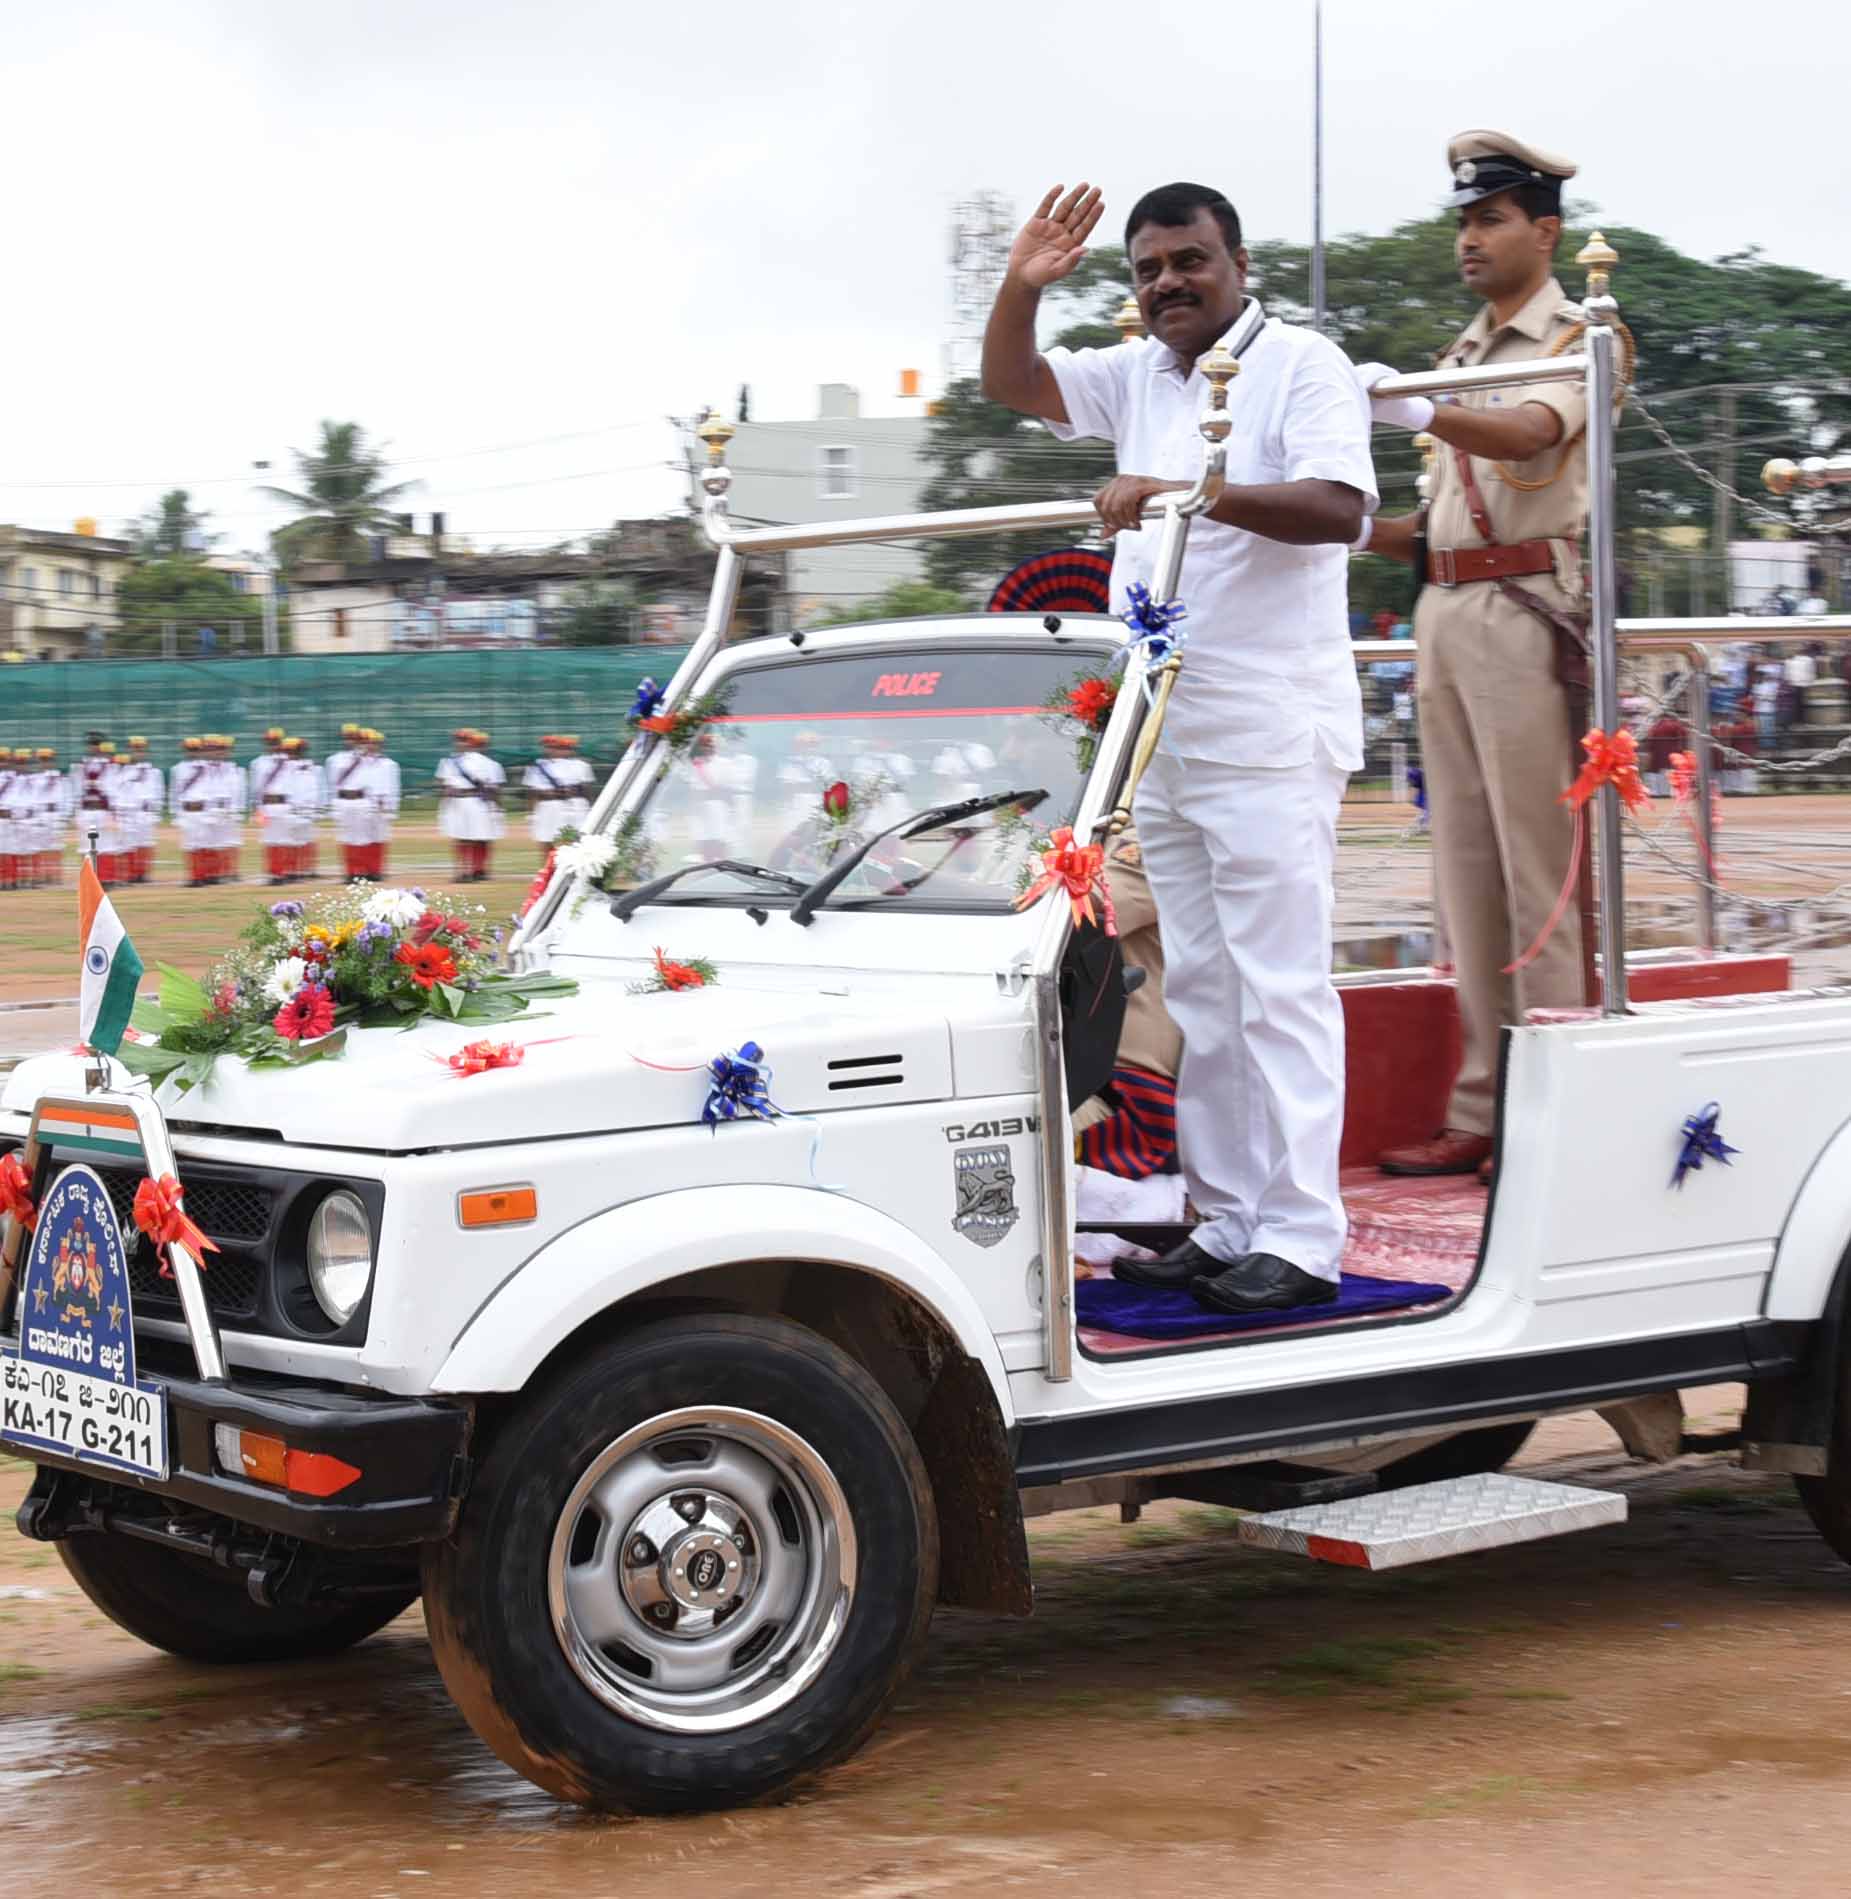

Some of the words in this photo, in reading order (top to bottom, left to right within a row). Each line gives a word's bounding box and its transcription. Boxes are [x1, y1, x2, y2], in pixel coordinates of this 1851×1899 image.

[871, 672, 943, 697] POLICE
[28, 1326, 93, 1364] ದಾವಣಗೆರೆ
[4, 1397, 72, 1441] KA-17
[81, 1418, 152, 1466] G-211
